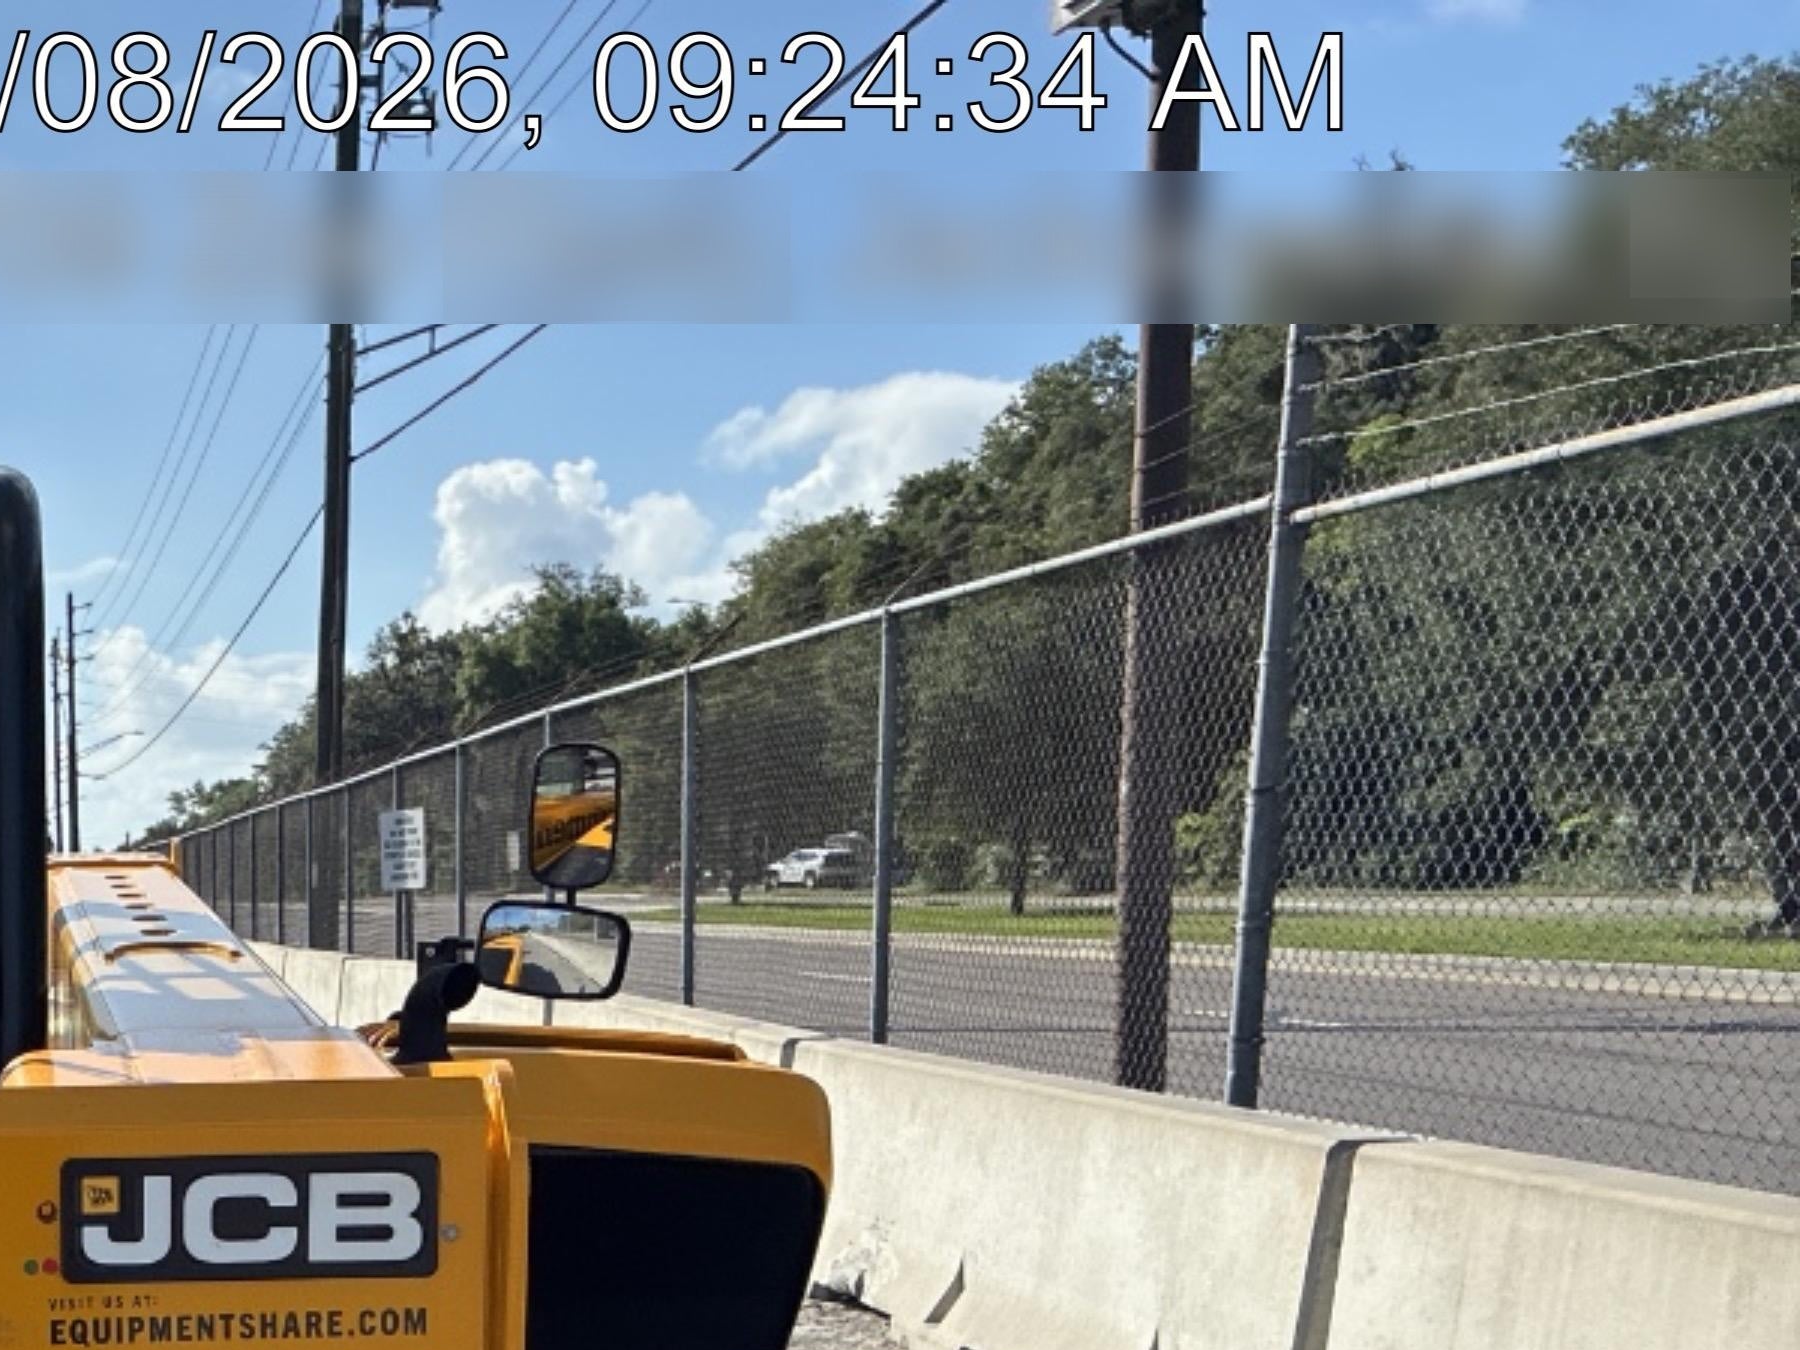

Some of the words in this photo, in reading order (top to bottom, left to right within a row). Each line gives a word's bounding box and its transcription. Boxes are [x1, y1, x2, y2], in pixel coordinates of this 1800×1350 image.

[81, 1171, 424, 1265] JCB
[48, 1296, 94, 1312] VISIT
[103, 1295, 125, 1309] US
[132, 1294, 160, 1309] AT:
[49, 1307, 428, 1348] EQUIPMENTSHARE.COM
